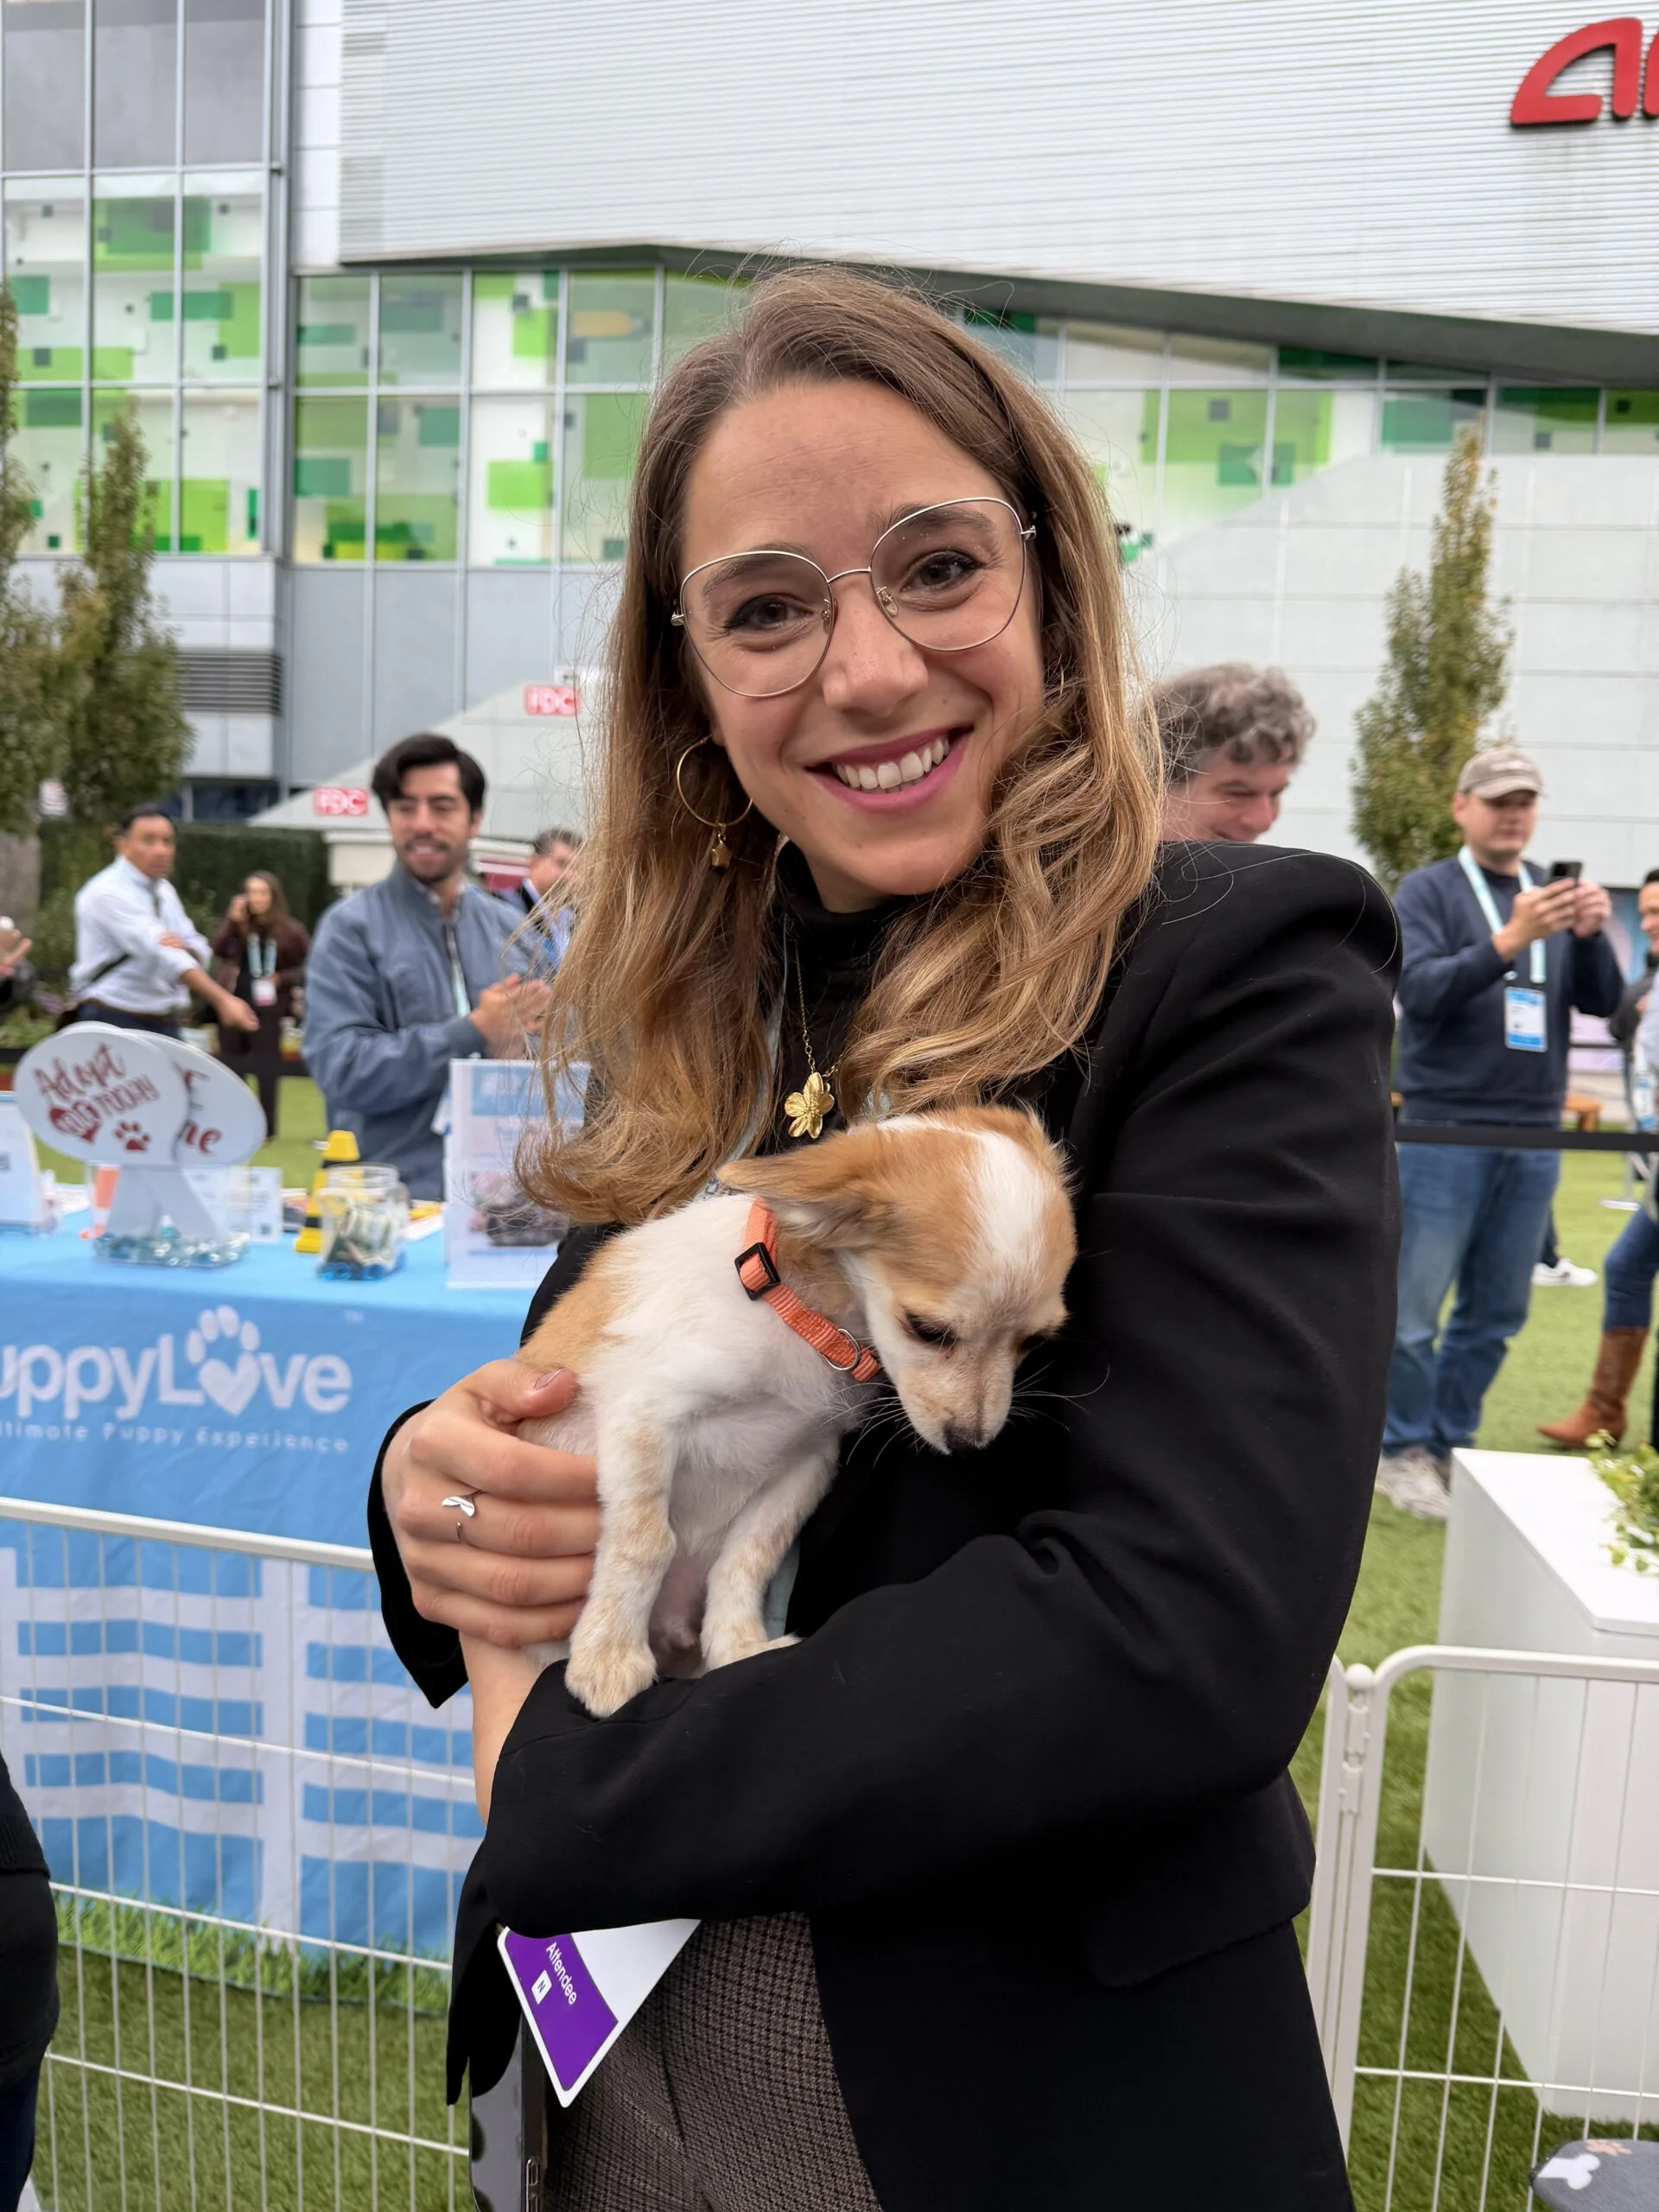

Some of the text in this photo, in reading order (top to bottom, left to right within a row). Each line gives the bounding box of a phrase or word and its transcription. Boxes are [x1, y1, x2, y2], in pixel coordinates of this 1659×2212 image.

[34, 1043, 125, 1102] Adopt
[103, 1422, 184, 1447] Puppy
[195, 1427, 349, 1454] Experience
[545, 1942, 577, 2005] Attendee
